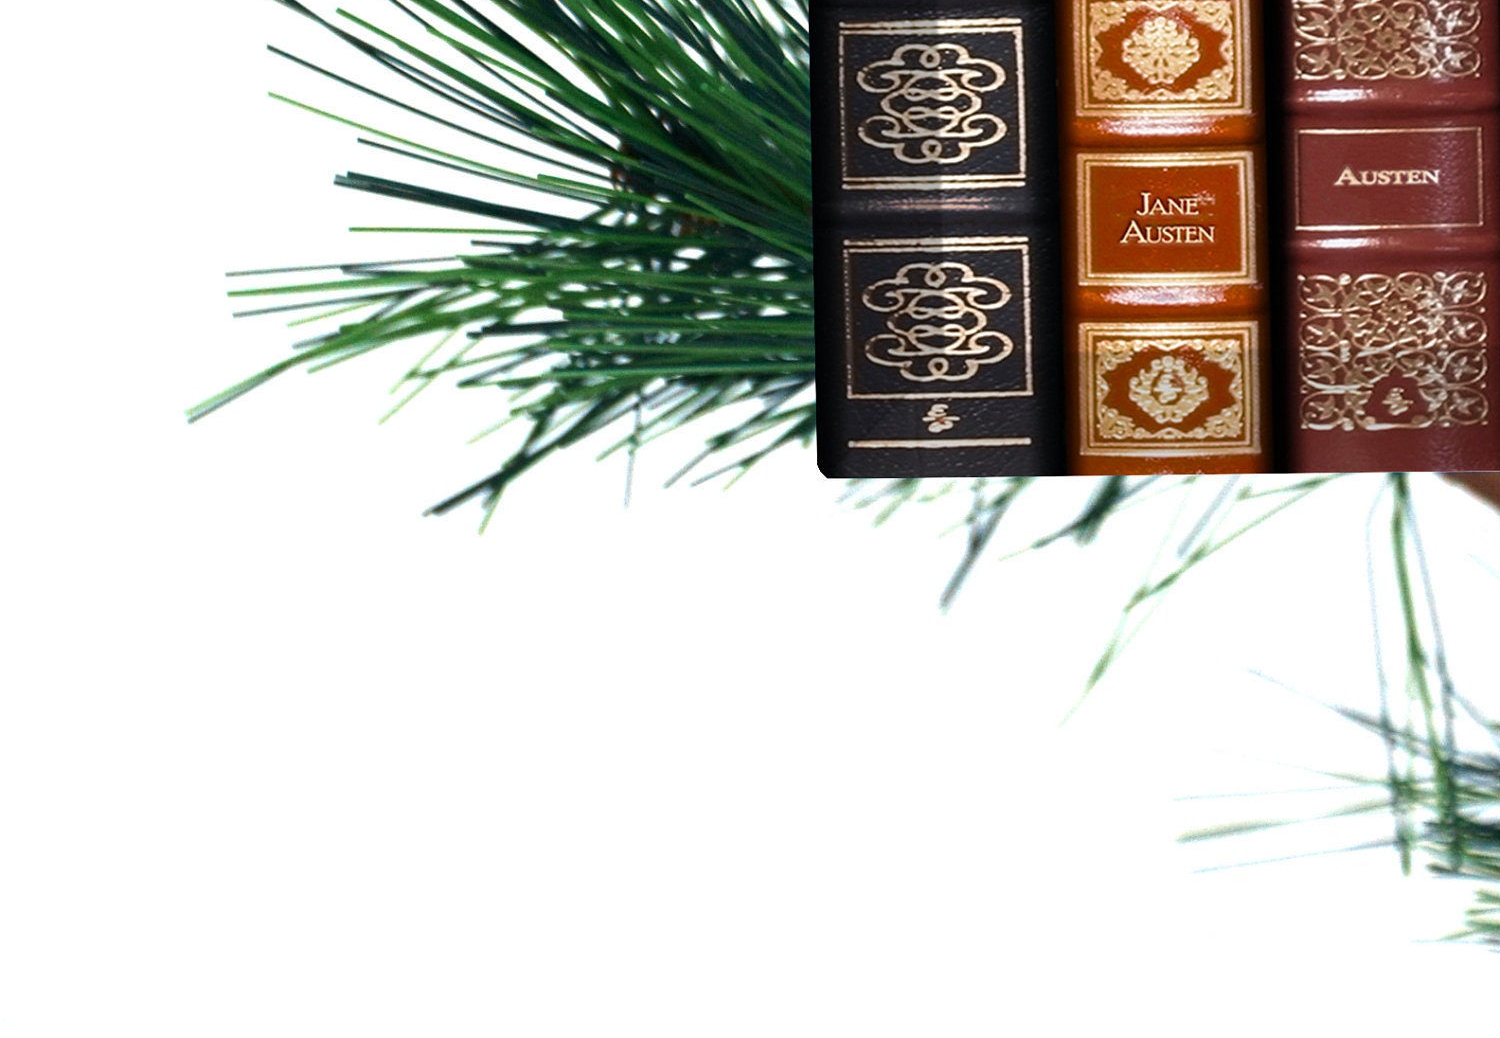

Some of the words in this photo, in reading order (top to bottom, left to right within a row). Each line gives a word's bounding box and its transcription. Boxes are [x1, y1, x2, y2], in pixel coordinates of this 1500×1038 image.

[1334, 167, 1440, 187] AUSTEN
[1136, 191, 1199, 218] JANE
[1120, 220, 1215, 245] AUSTEN
